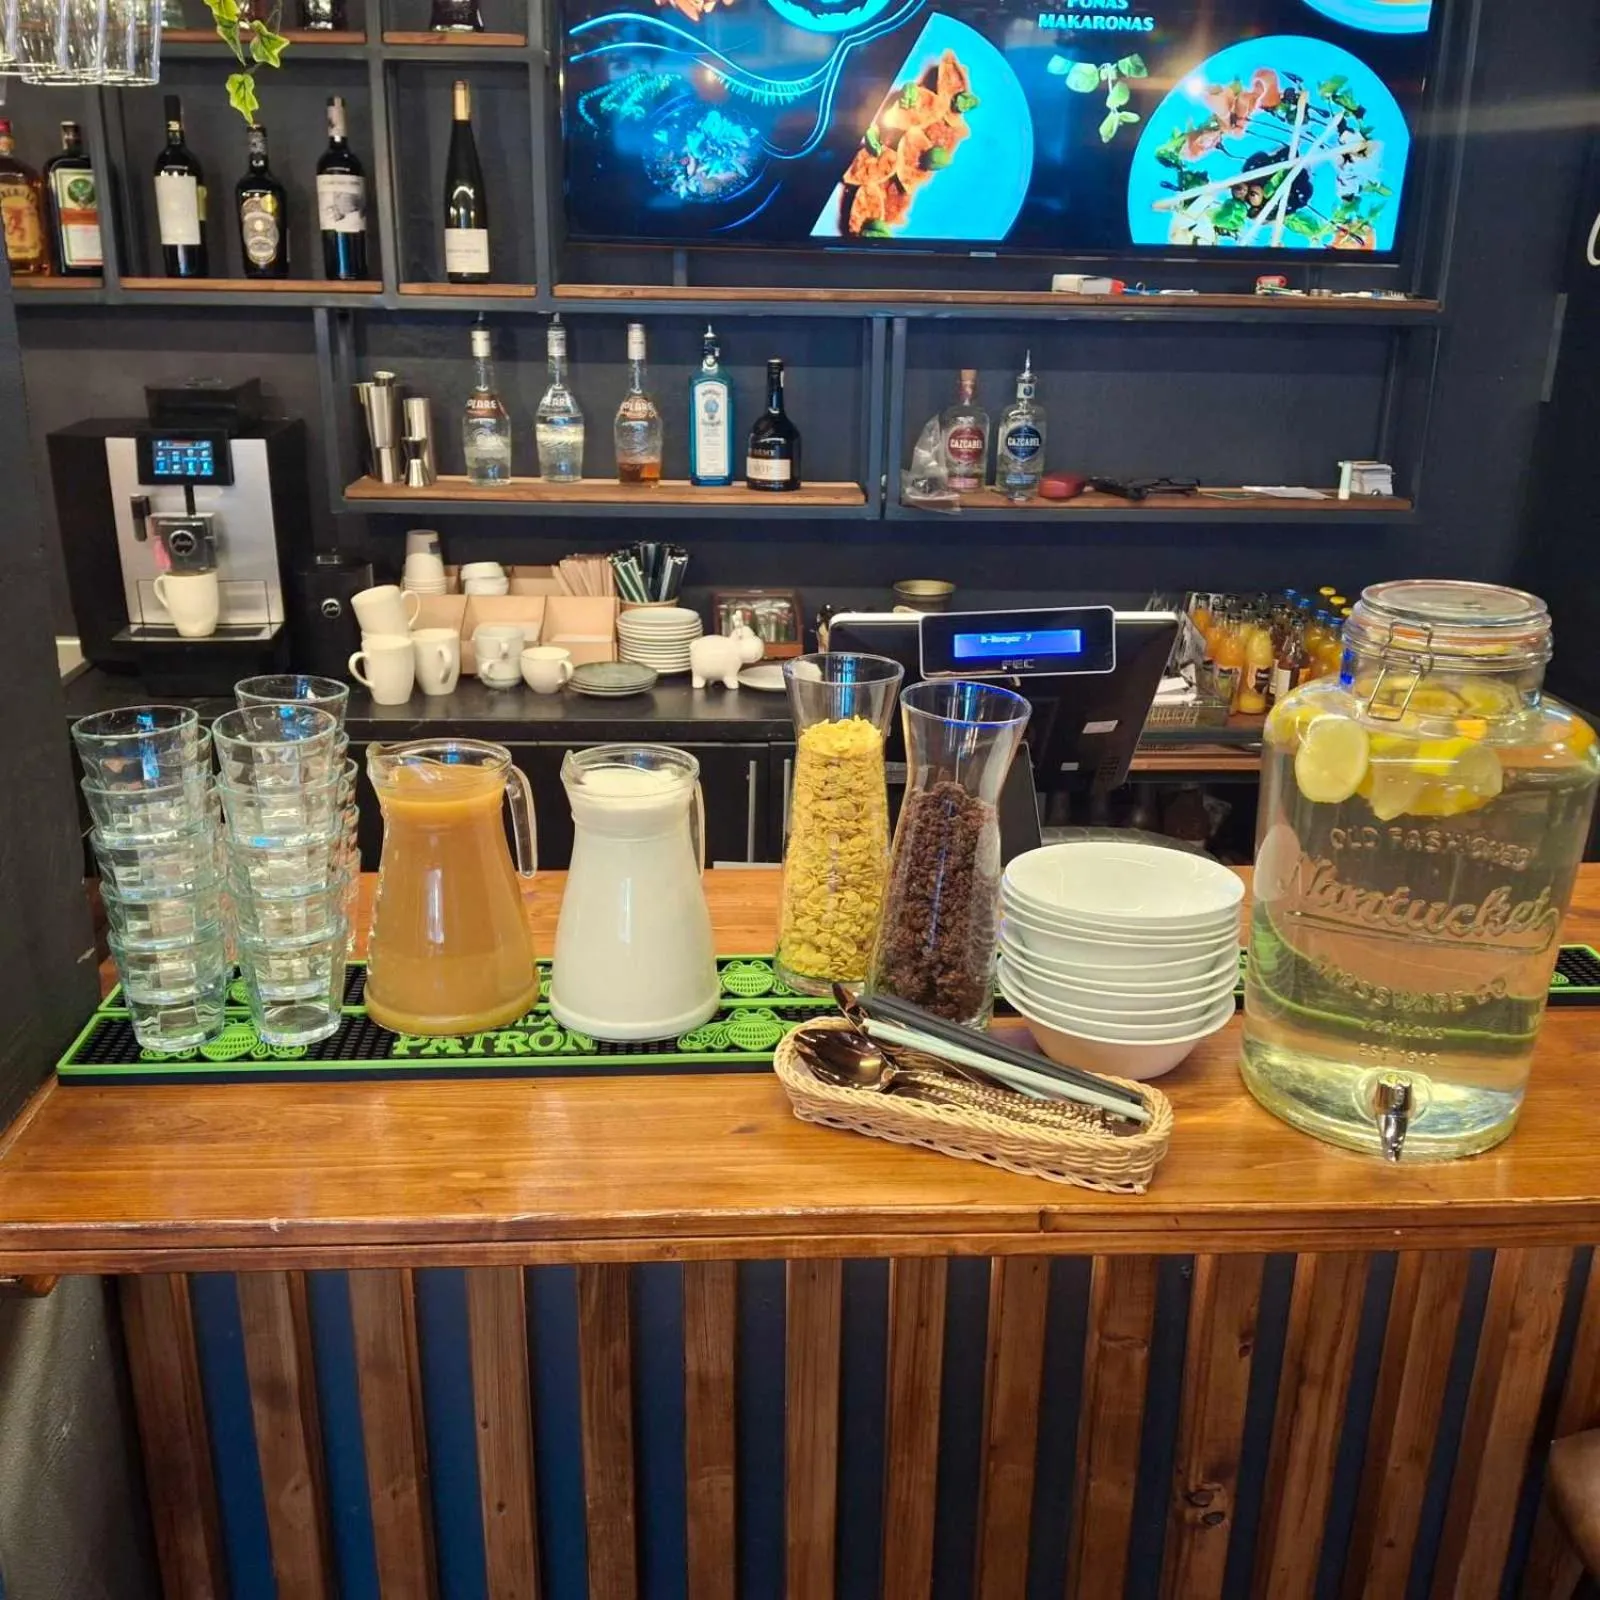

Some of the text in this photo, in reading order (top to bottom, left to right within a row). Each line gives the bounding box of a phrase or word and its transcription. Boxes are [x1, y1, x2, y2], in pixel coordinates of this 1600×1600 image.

[1038, 13, 1154, 31] MAKARONAS
[1330, 826, 1379, 850] OLD
[1277, 853, 1560, 938] Nantucket
[392, 1027, 597, 1056] PATRÓN
